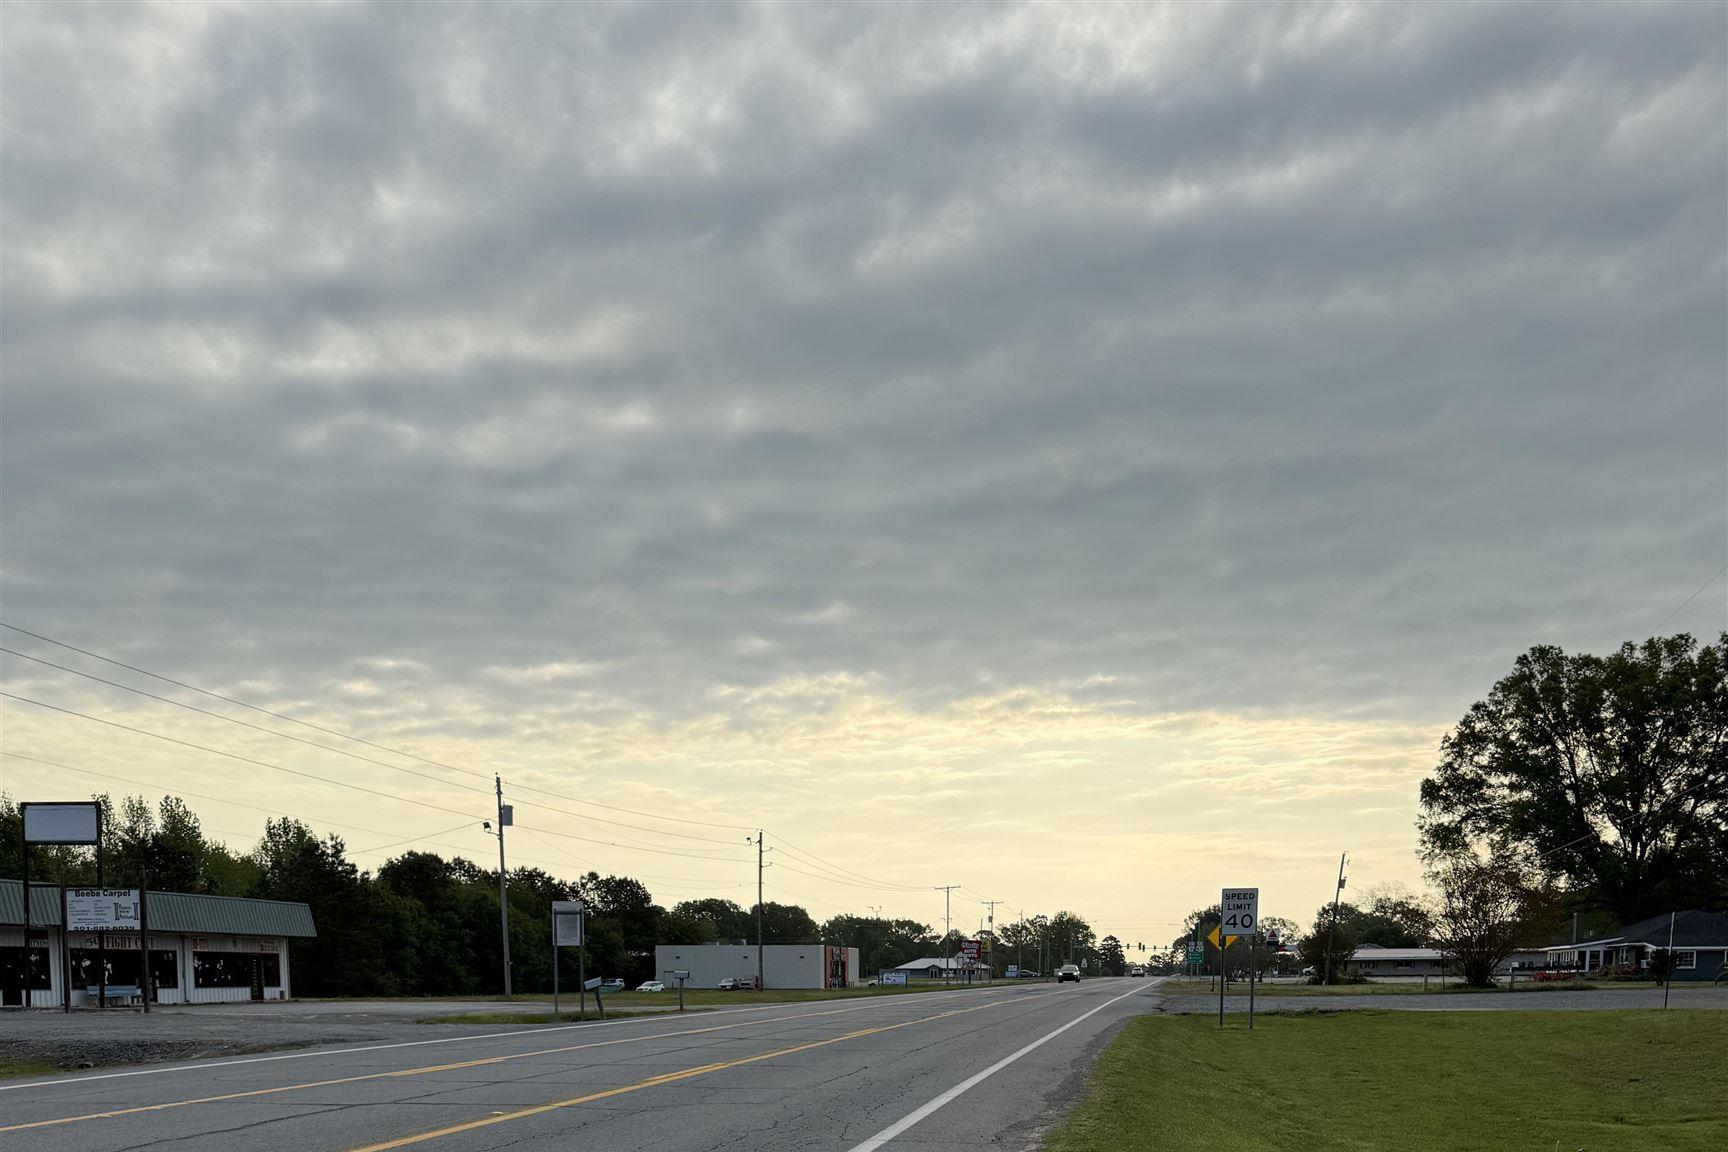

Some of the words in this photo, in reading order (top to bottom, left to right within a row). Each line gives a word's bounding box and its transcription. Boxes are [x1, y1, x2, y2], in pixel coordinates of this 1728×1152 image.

[75, 889, 101, 897] Beebe
[102, 889, 131, 898] Carpet
[1225, 914, 1253, 928] 40
